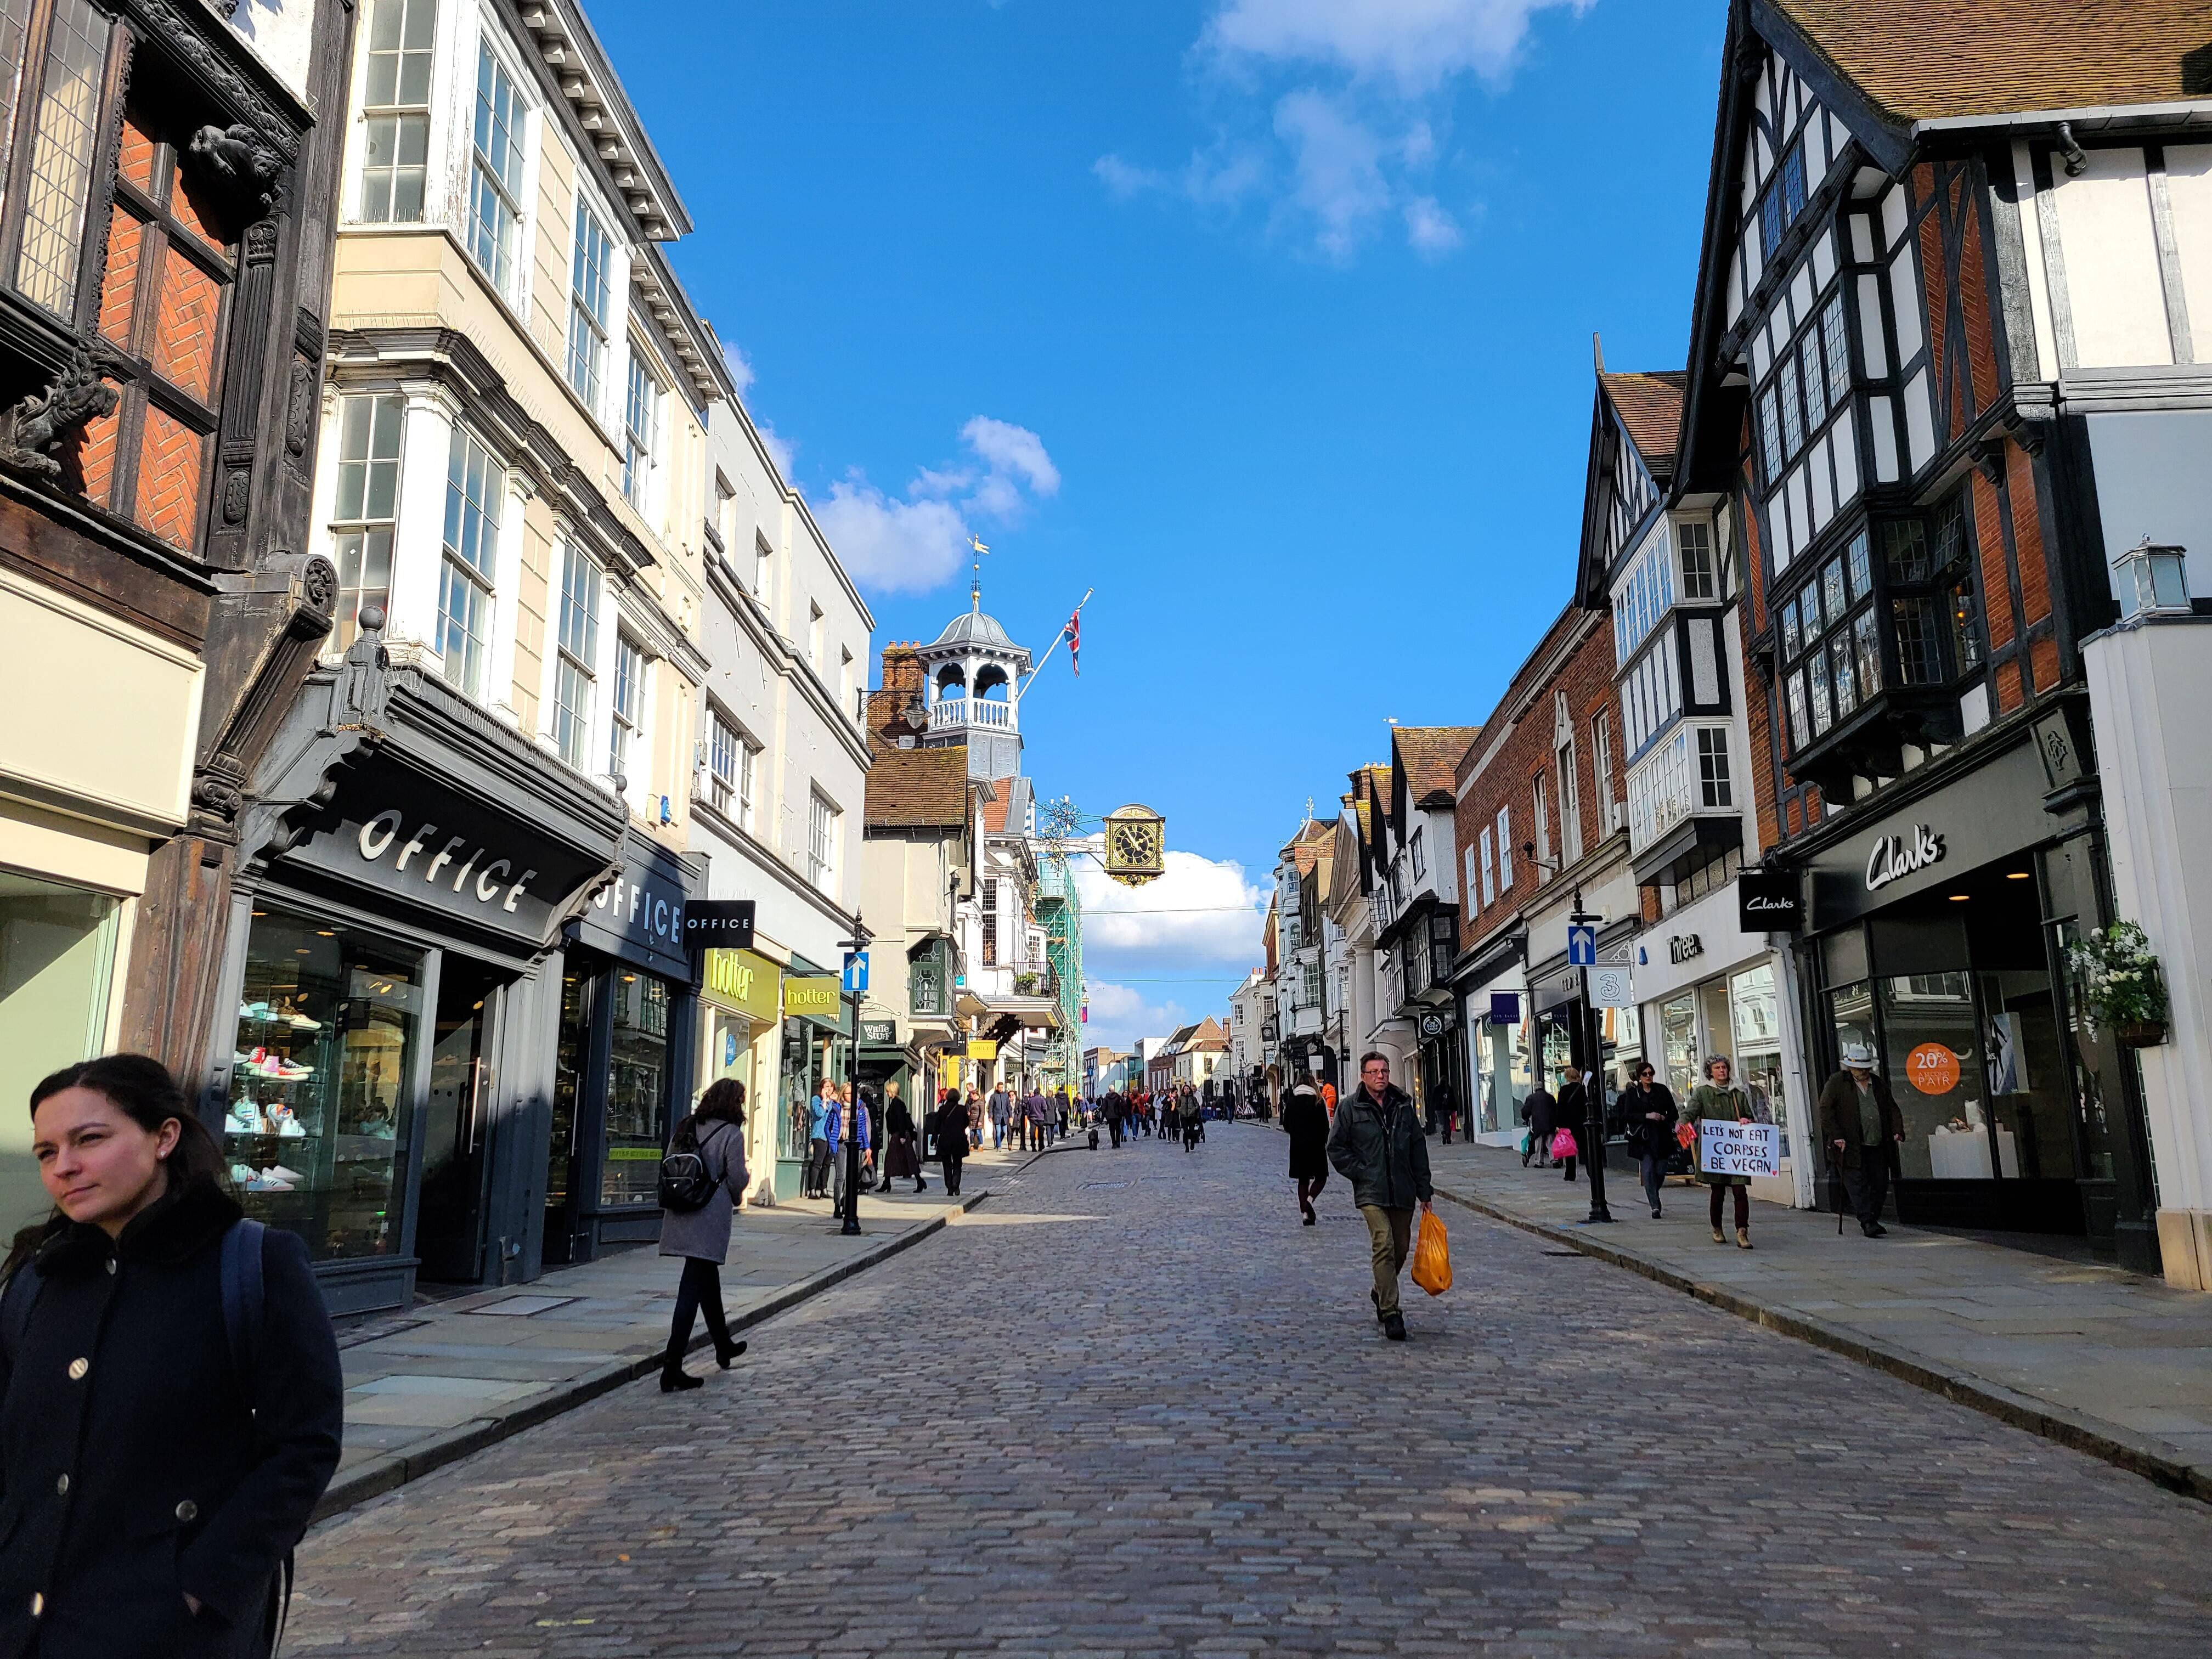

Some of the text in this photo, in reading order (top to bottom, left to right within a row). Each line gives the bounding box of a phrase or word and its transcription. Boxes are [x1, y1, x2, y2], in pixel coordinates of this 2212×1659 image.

[358, 809, 539, 913] OFFICE
[1866, 823, 1939, 891] Clarks
[1746, 896, 1794, 910] Clarks
[687, 918, 749, 929] OFFICE
[712, 948, 754, 1002] hotter
[1600, 973, 1620, 998] 3
[787, 989, 837, 1005] hotter
[1915, 1052, 1948, 1069] 20%
[1918, 1076, 1950, 1086] PAIR
[1703, 1124, 1770, 1141] LET'S NOT EAT
[1713, 1142, 1768, 1158] CORPSES
[1711, 1157, 1771, 1173] BE VEGAN
